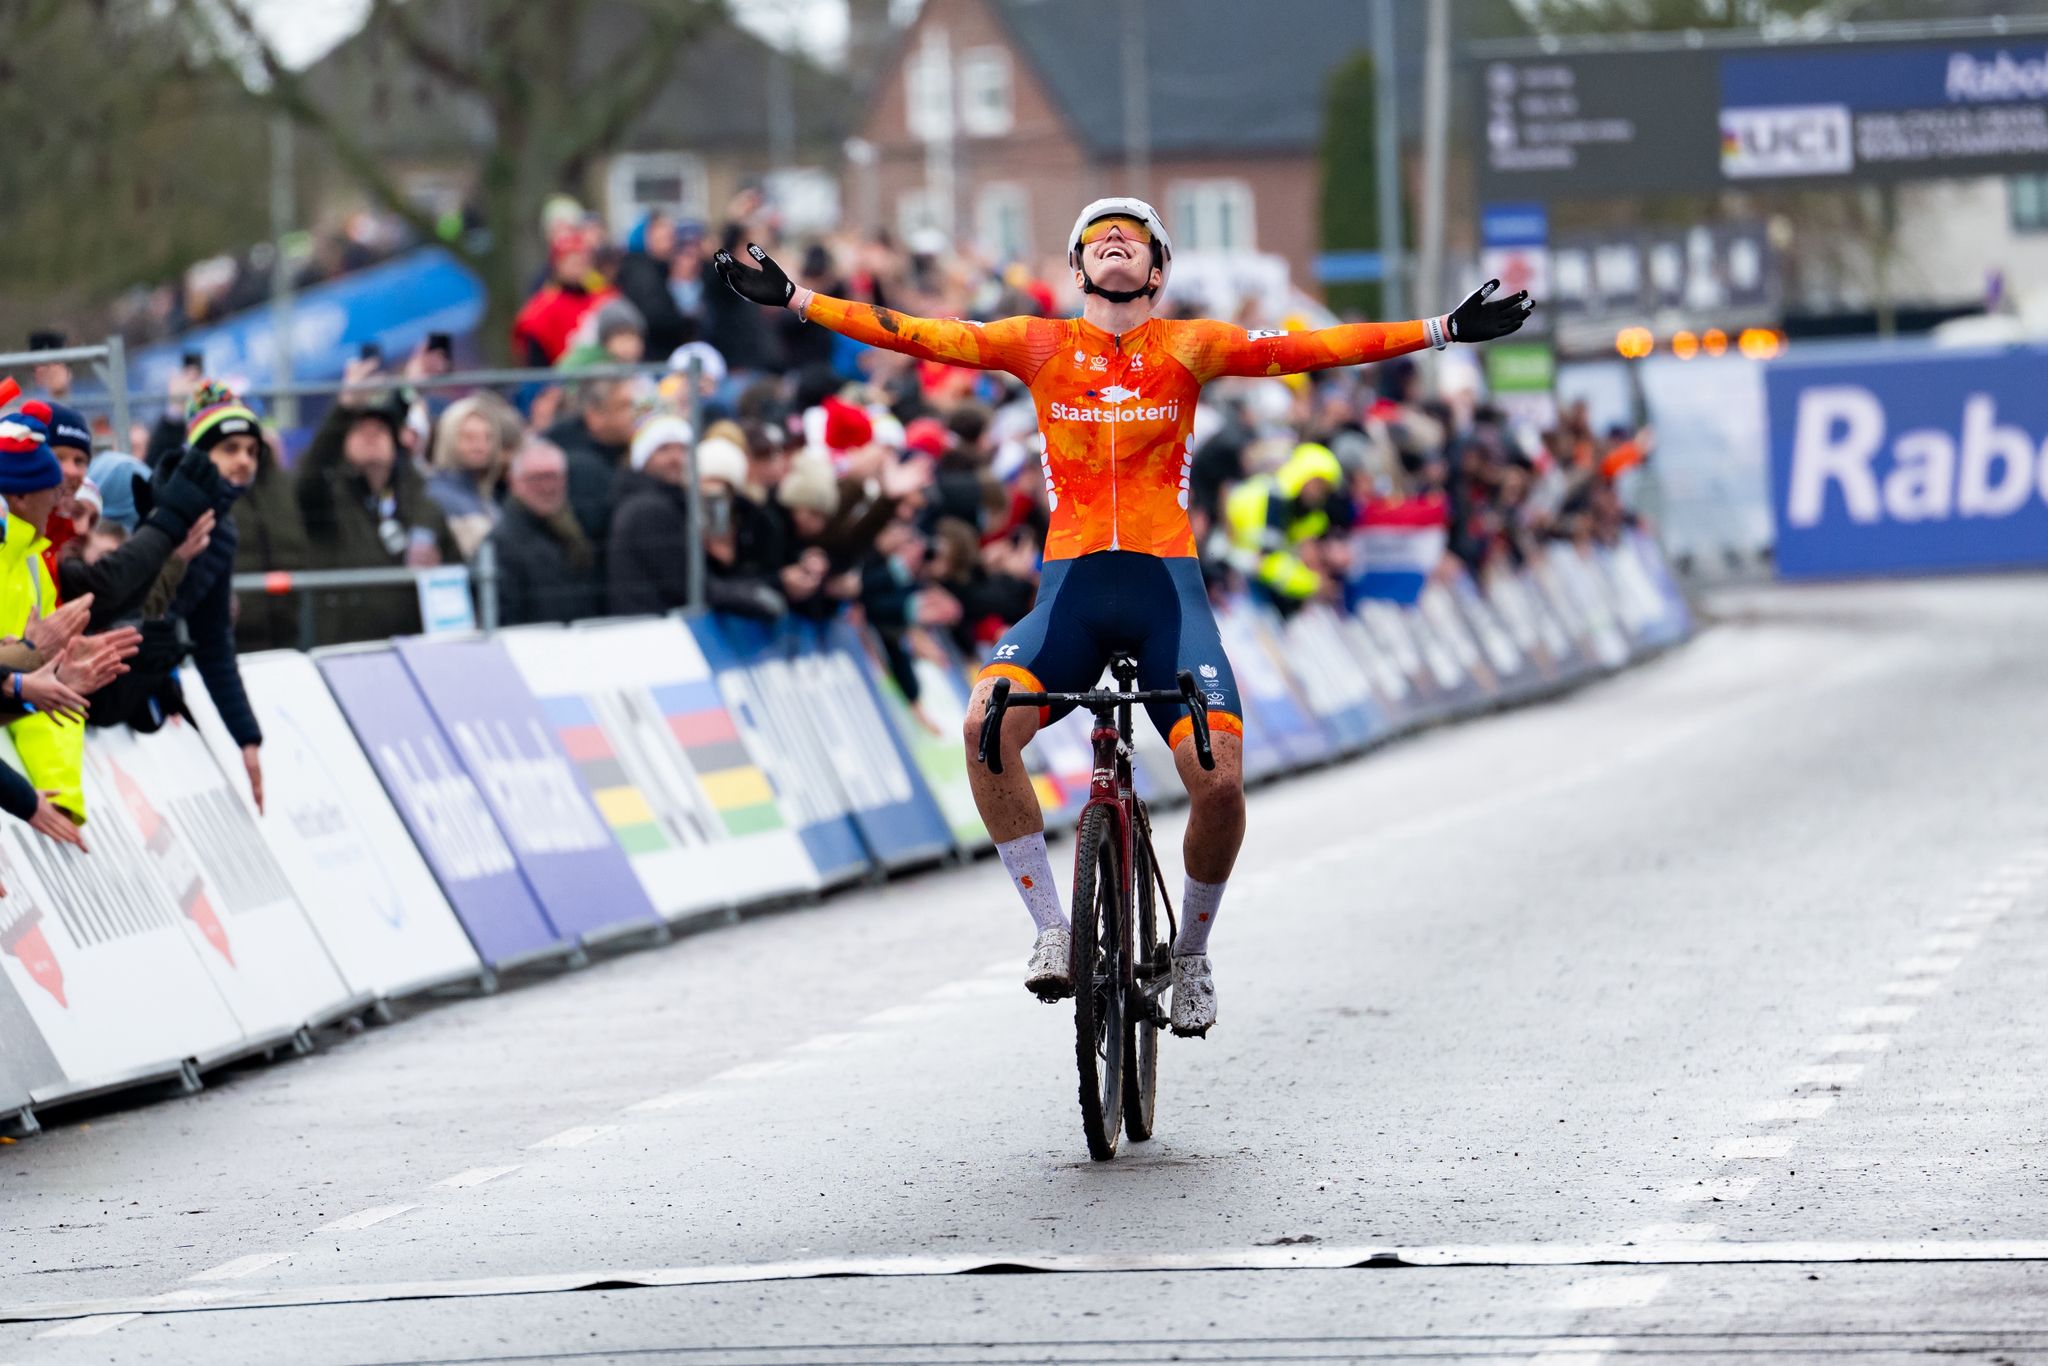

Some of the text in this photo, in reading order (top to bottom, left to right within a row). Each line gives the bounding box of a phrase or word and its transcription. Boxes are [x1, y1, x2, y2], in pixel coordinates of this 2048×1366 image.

[1945, 53, 2048, 101] Rabo
[1740, 118, 1838, 157] UCI
[1050, 399, 1179, 423] Staatsloterij
[1787, 384, 2048, 529] Rab
